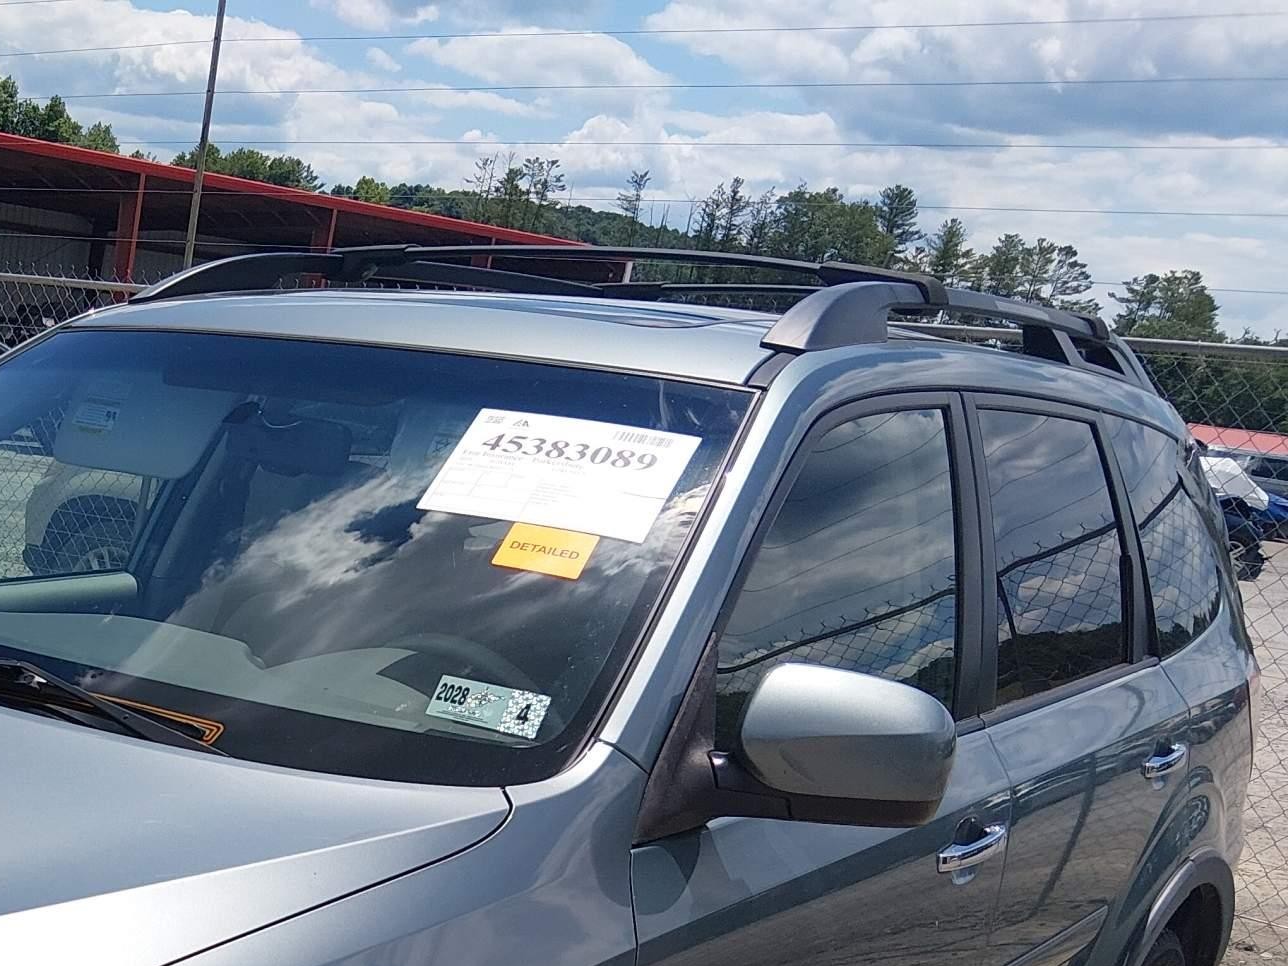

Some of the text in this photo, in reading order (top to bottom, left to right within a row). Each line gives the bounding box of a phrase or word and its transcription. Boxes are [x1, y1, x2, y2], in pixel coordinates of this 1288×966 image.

[482, 433, 658, 470] 45383089
[510, 541, 579, 560] DETAILED
[435, 683, 470, 705] 2028
[516, 704, 531, 724] 4
